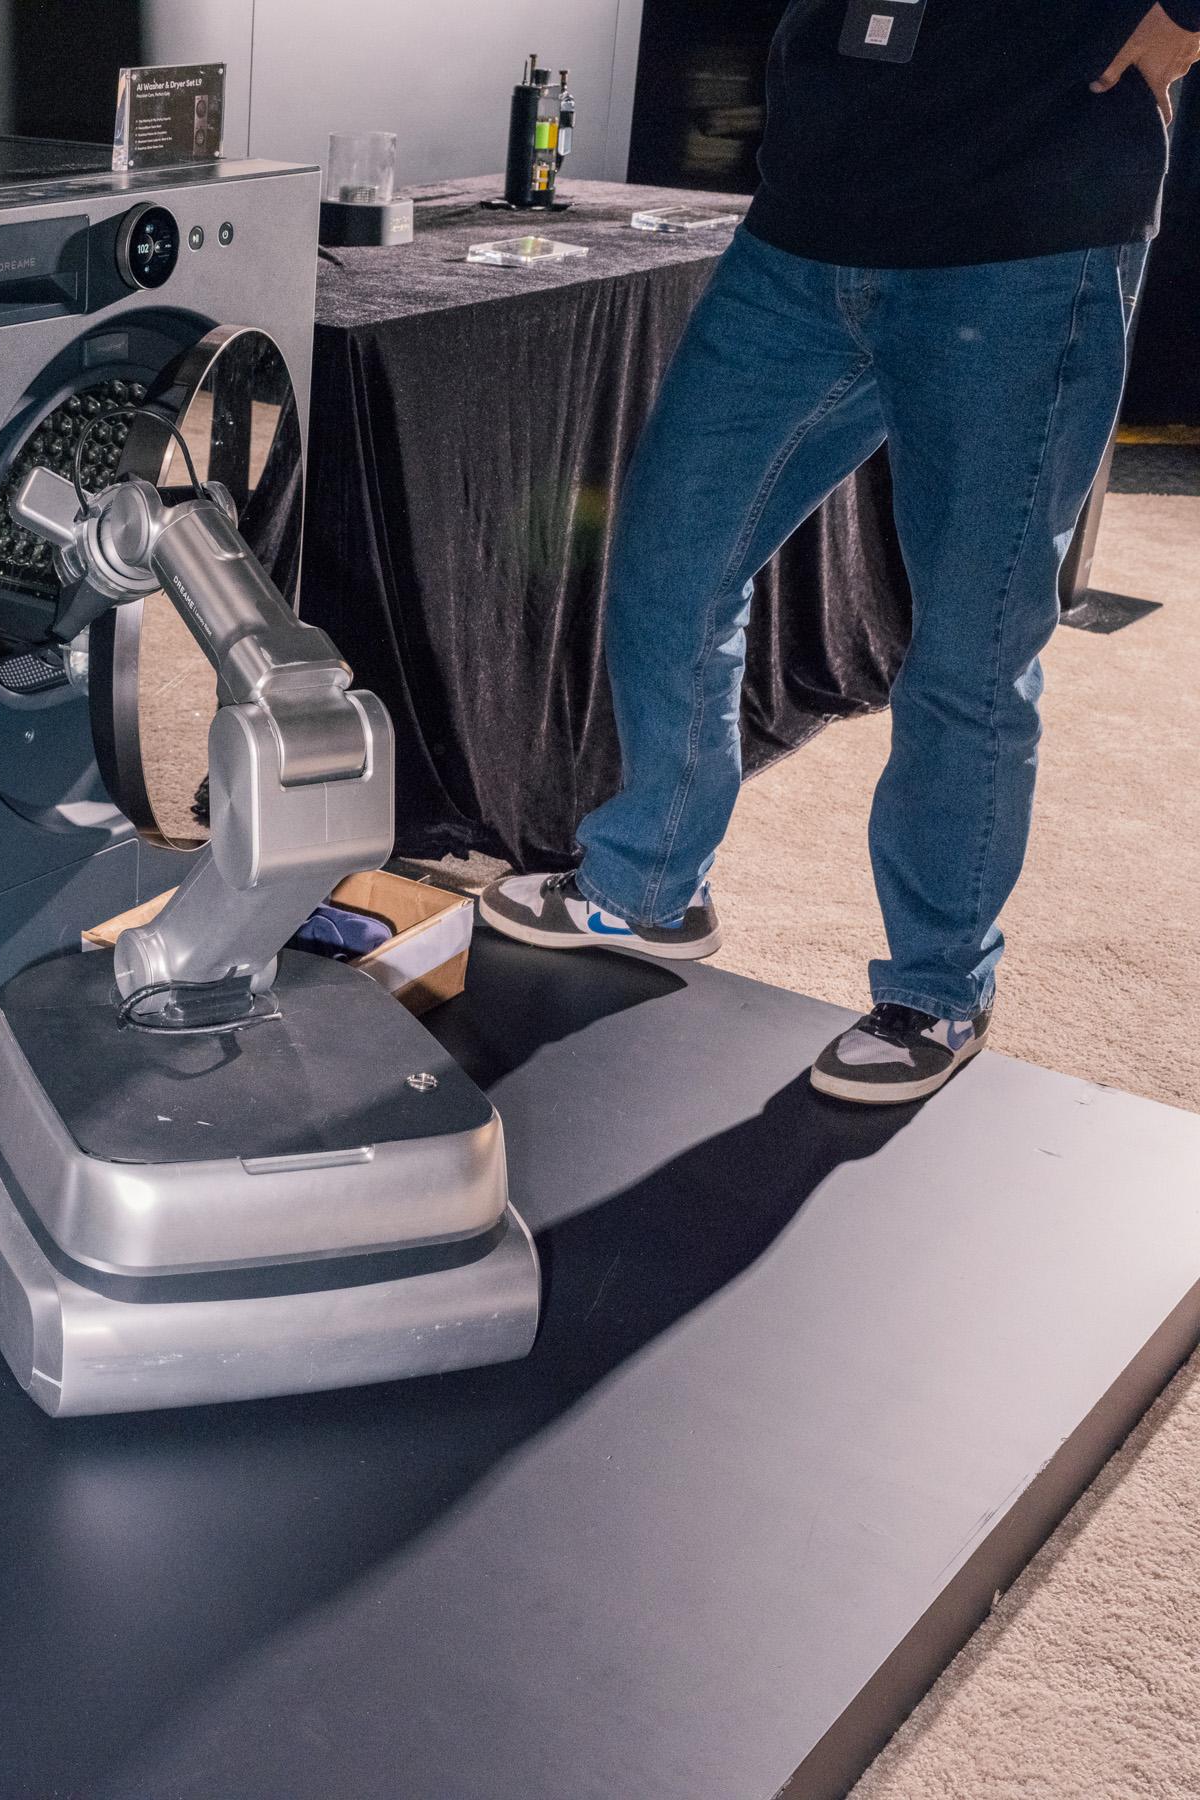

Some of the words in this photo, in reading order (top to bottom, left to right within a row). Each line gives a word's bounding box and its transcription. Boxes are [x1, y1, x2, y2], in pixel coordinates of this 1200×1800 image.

[137, 83, 143, 91] AI
[165, 81, 170, 89] &
[170, 81, 186, 90] Dryer
[186, 79, 195, 87] Set
[137, 243, 150, 255] 102
[173, 575, 195, 610] DREAME
